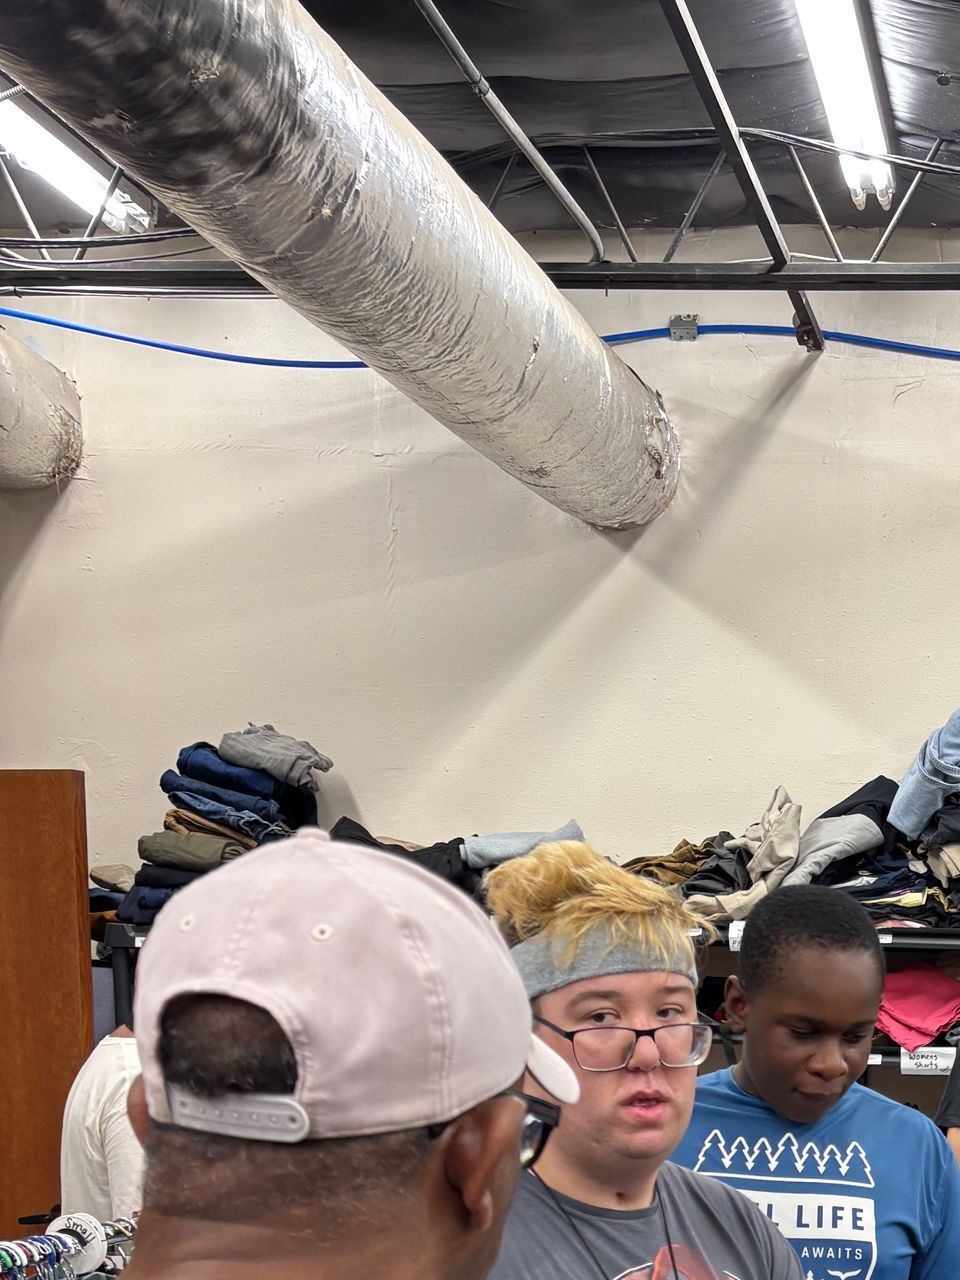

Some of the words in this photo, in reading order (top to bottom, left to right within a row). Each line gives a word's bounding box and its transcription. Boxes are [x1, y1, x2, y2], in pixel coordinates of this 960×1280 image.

[908, 1053, 938, 1061] Womens
[797, 1205, 864, 1231] LIFE
[65, 1217, 96, 1243] Small
[801, 1246, 863, 1260] AWAITS
